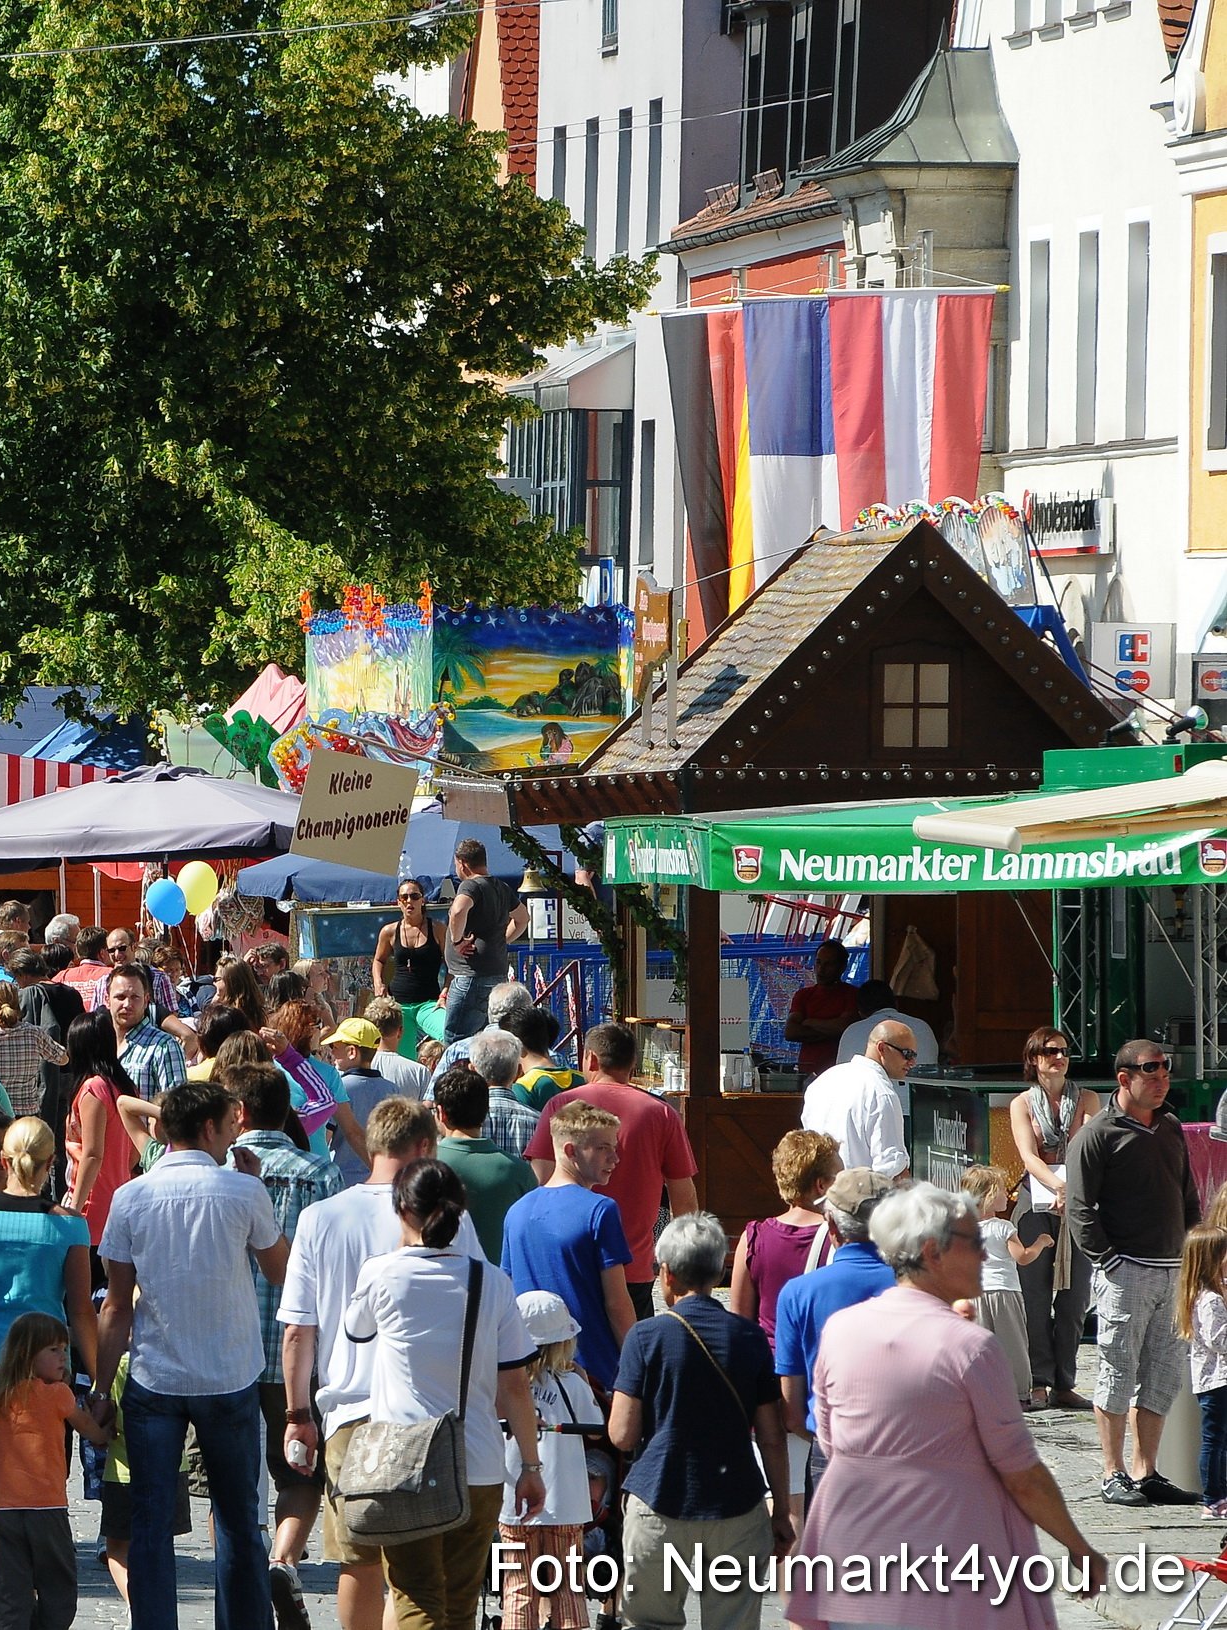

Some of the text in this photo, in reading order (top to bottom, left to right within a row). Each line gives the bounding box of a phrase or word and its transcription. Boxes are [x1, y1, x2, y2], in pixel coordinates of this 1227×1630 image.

[329, 770, 373, 795] Kleine
[296, 803, 408, 840] Champignonerie
[779, 842, 1182, 882] Neumarkter Lammsbräu
